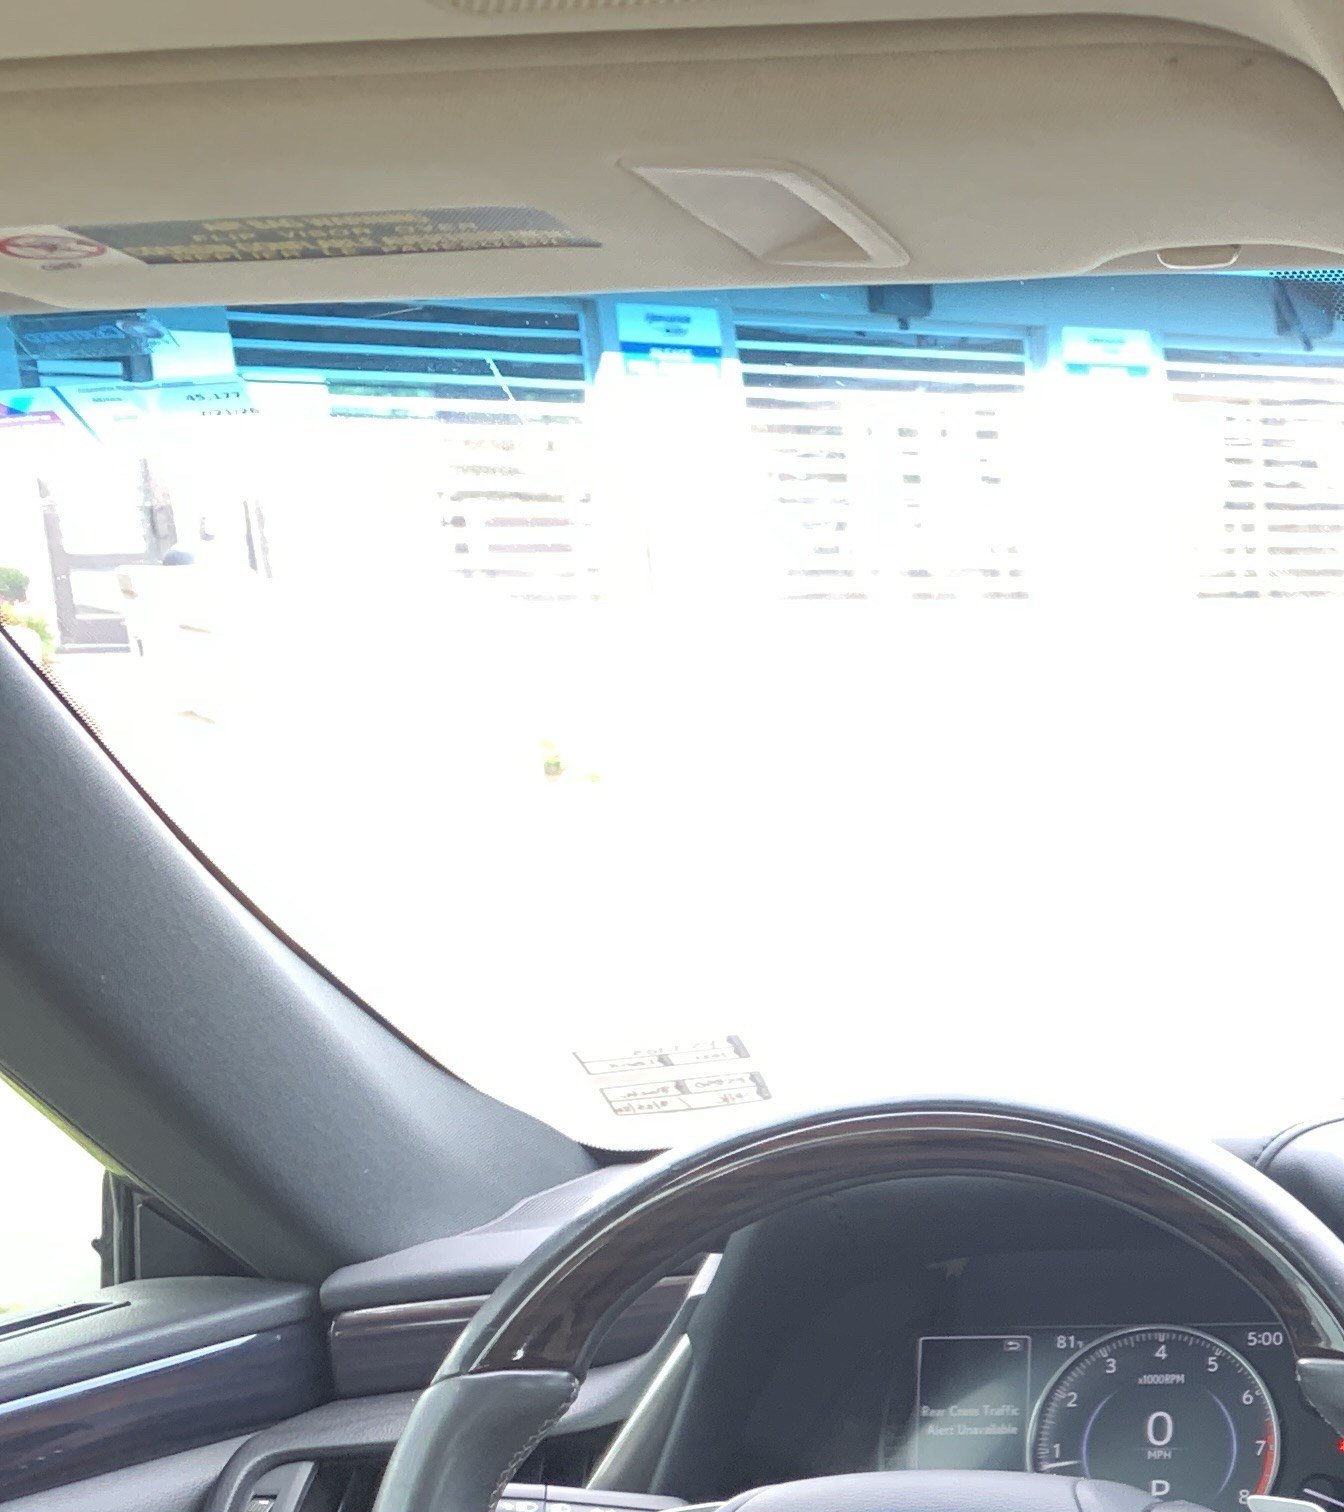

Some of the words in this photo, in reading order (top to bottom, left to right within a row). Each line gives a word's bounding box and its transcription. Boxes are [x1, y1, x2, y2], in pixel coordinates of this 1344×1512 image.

[1248, 1332, 1283, 1346] 5:00
[1154, 1345, 1168, 1360] 4
[1105, 1358, 1117, 1374] 3
[1207, 1357, 1219, 1372] 5
[1066, 1392, 1079, 1407] 2
[1242, 1389, 1254, 1405] 6
[982, 1404, 1020, 1416] Traffic
[1146, 1411, 1173, 1446] 0
[1053, 1443, 1061, 1458] 1
[1147, 1450, 1172, 1460] MPH
[1255, 1440, 1266, 1456] 7
[1238, 1489, 1249, 1504] 8
